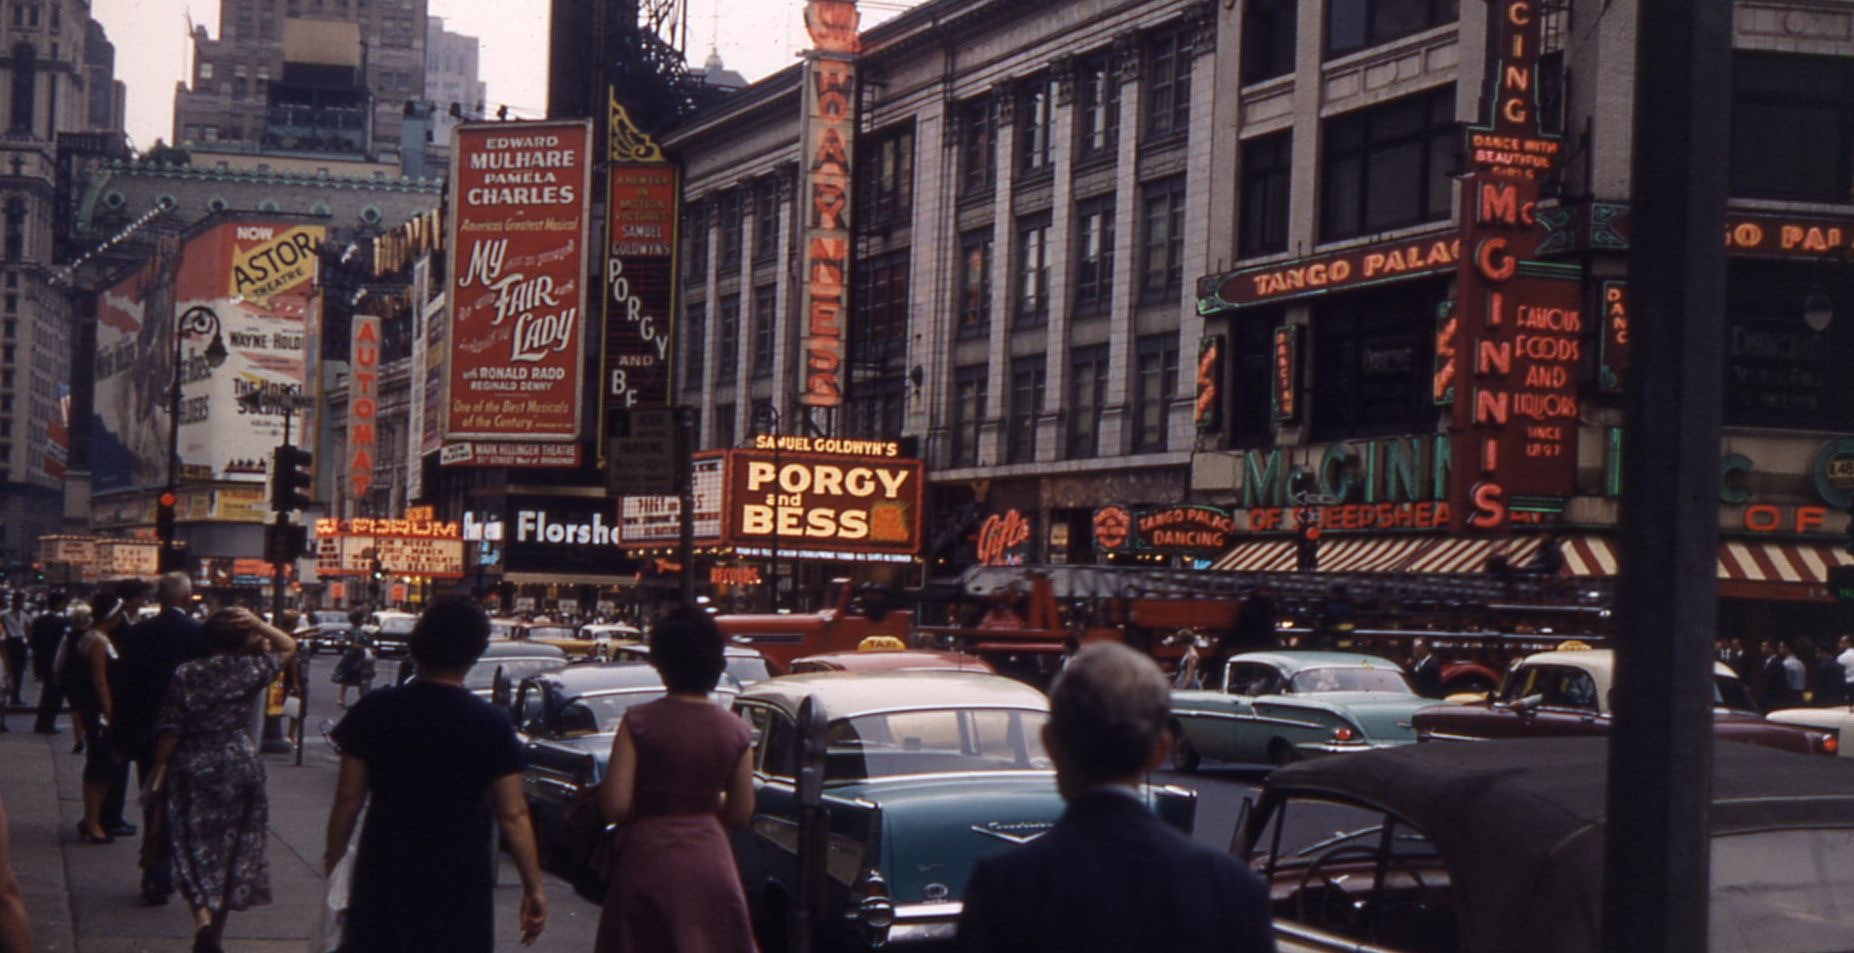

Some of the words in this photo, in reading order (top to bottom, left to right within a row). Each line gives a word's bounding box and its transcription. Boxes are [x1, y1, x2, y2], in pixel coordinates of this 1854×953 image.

[486, 136, 559, 149] EDWARD
[1472, 134, 1520, 150] DANCE
[470, 150, 575, 169] MULHARE
[484, 172, 556, 184] PAMELA
[467, 185, 575, 205] CHARLES
[505, 217, 543, 232] Greatest
[544, 216, 578, 231] Musical
[236, 226, 273, 240] NOW
[233, 231, 317, 294] ASTOR
[253, 266, 303, 297] THEATRE
[1254, 260, 1350, 295] TANGO
[608, 258, 669, 360] PORGY
[1516, 305, 1580, 331] FAMOUS
[230, 332, 267, 349] WAYNE
[1514, 334, 1579, 360] FOODS
[619, 355, 653, 367] AND
[480, 367, 527, 379] RONALD
[532, 367, 565, 379] RADD
[1525, 365, 1566, 388] AND
[233, 378, 256, 394] THE
[470, 381, 517, 390] REGINALD
[520, 381, 553, 391] DENNY
[351, 320, 379, 497] AUTOMAT
[454, 401, 471, 413] One
[473, 401, 484, 413] of
[485, 401, 501, 413] the
[502, 400, 526, 414] Best
[527, 401, 570, 414] Musicals
[462, 414, 475, 428] of
[475, 416, 492, 428] the
[1526, 427, 1561, 440] SINCE
[814, 439, 897, 456] GOLDWYN'S
[747, 461, 909, 498] PORGY
[766, 493, 802, 506] and
[742, 504, 868, 538] BESS
[1139, 509, 1184, 531] TANGO
[1249, 508, 1281, 531] OF
[1744, 504, 1825, 533] OF
[1153, 531, 1224, 547] DANCING
[867, 640, 897, 648] TAXI
